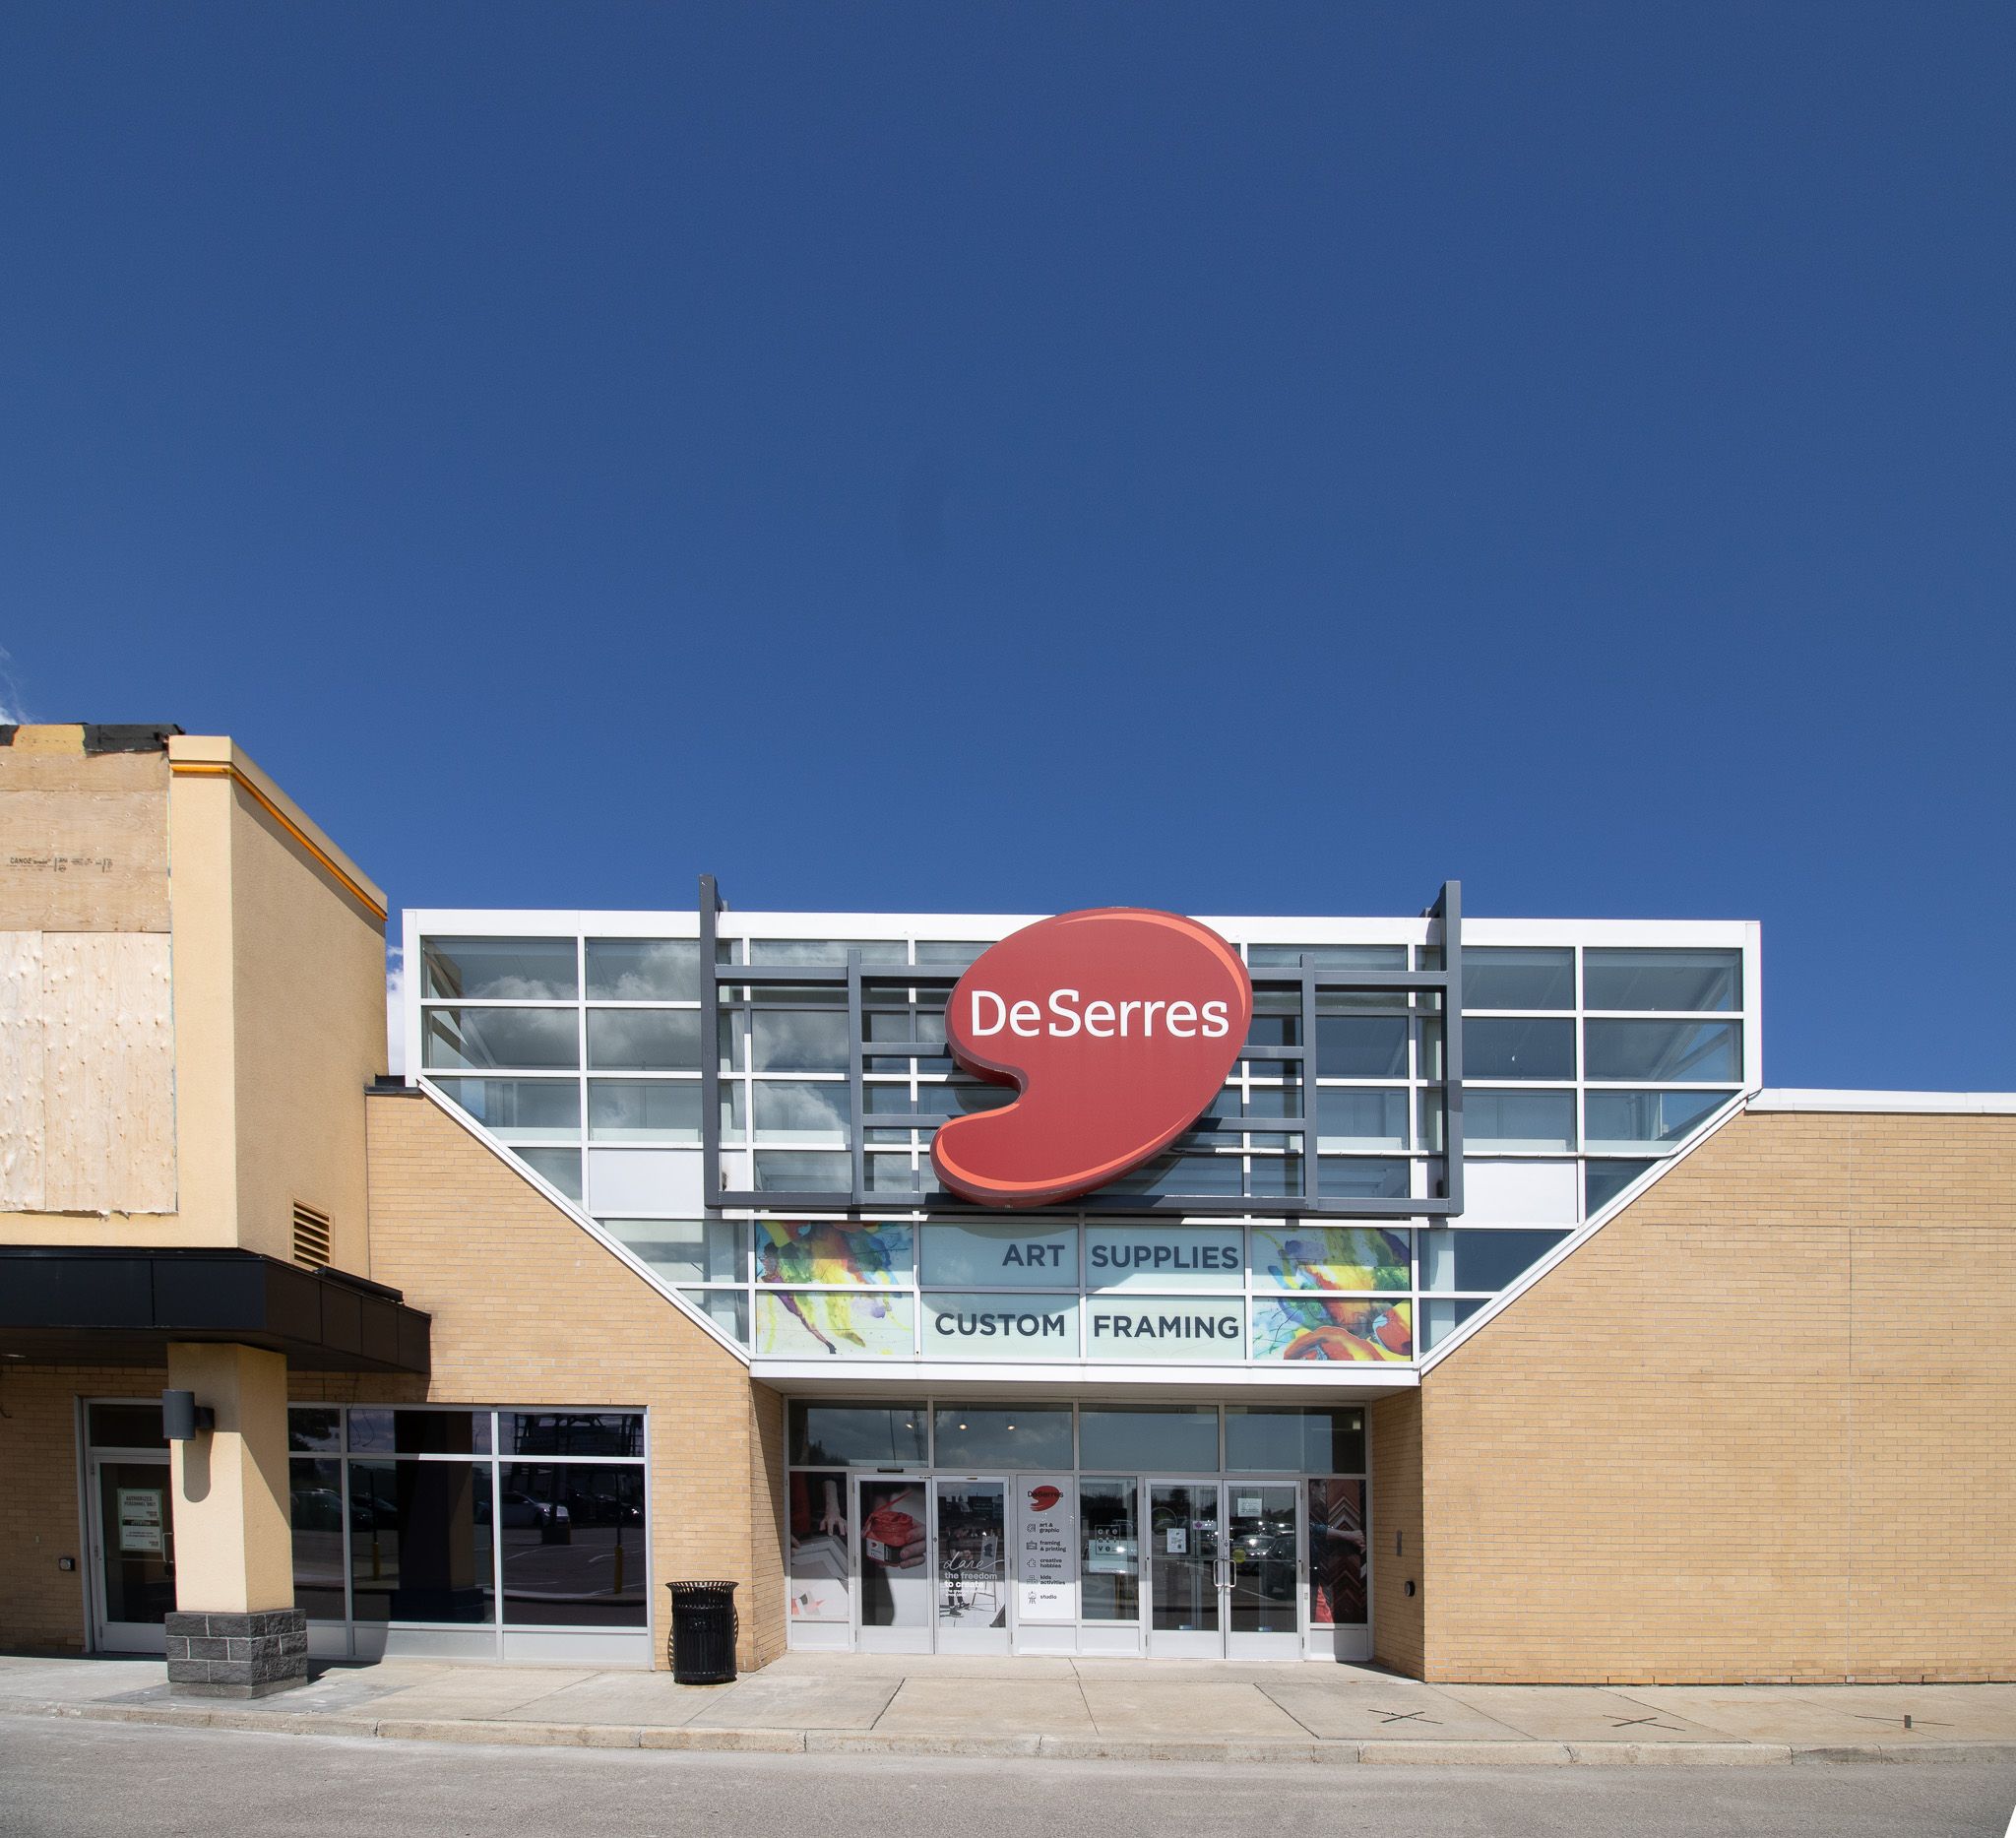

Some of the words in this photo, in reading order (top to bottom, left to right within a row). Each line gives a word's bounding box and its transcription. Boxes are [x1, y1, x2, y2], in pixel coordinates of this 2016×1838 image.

[971, 988, 1229, 1038] DeSerres
[1002, 1243, 1065, 1267] ART
[1092, 1244, 1239, 1270] SUPPLIES
[935, 1312, 1065, 1337] CUSTOM
[1094, 1315, 1239, 1339] FRAMING
[1027, 1489, 1064, 1498] DeSerres
